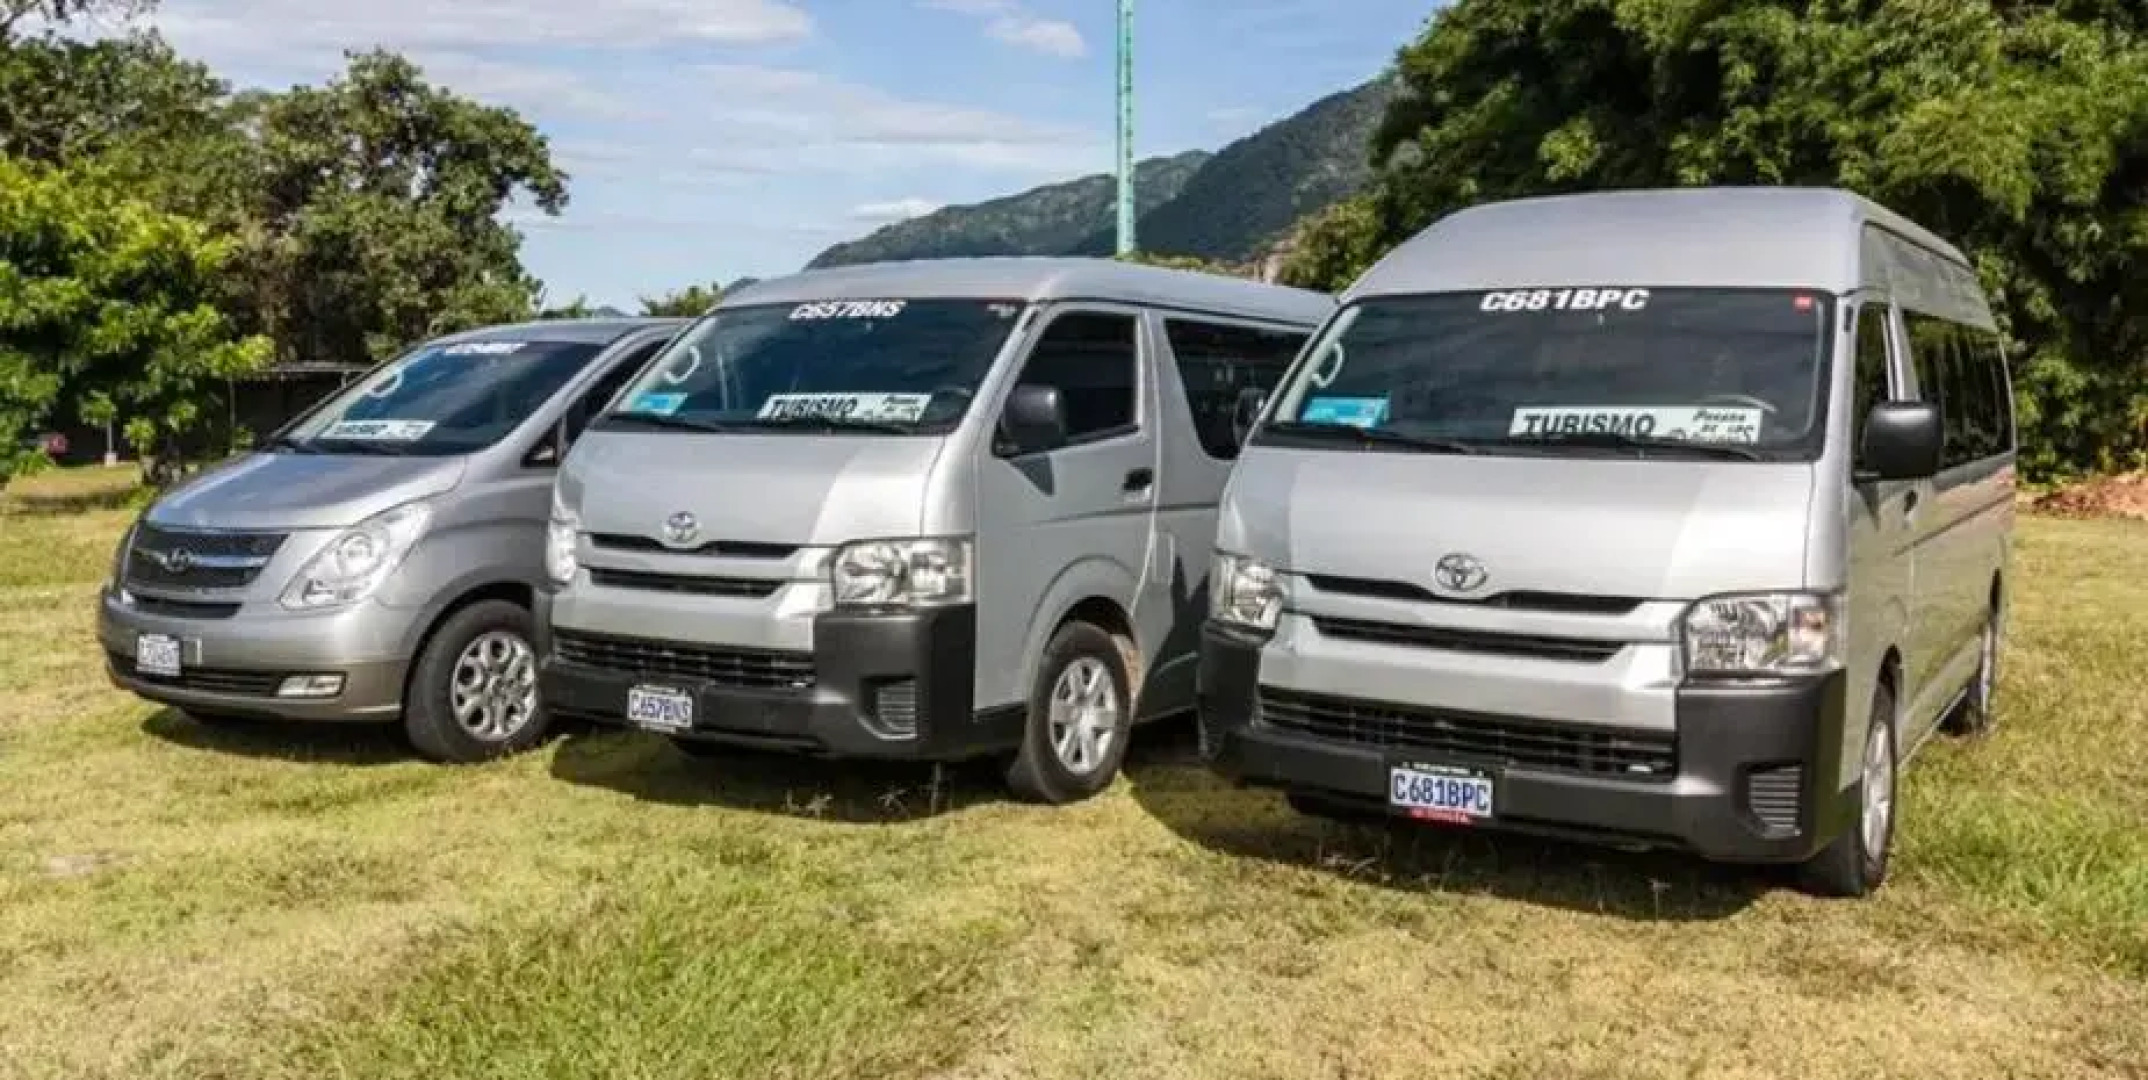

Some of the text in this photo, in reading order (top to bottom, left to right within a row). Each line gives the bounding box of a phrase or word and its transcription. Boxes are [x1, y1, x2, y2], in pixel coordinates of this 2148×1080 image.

[1480, 289, 1649, 312] C681BPC
[1523, 413, 1656, 438] TURISMO
[1394, 774, 1487, 811] C681BPC
